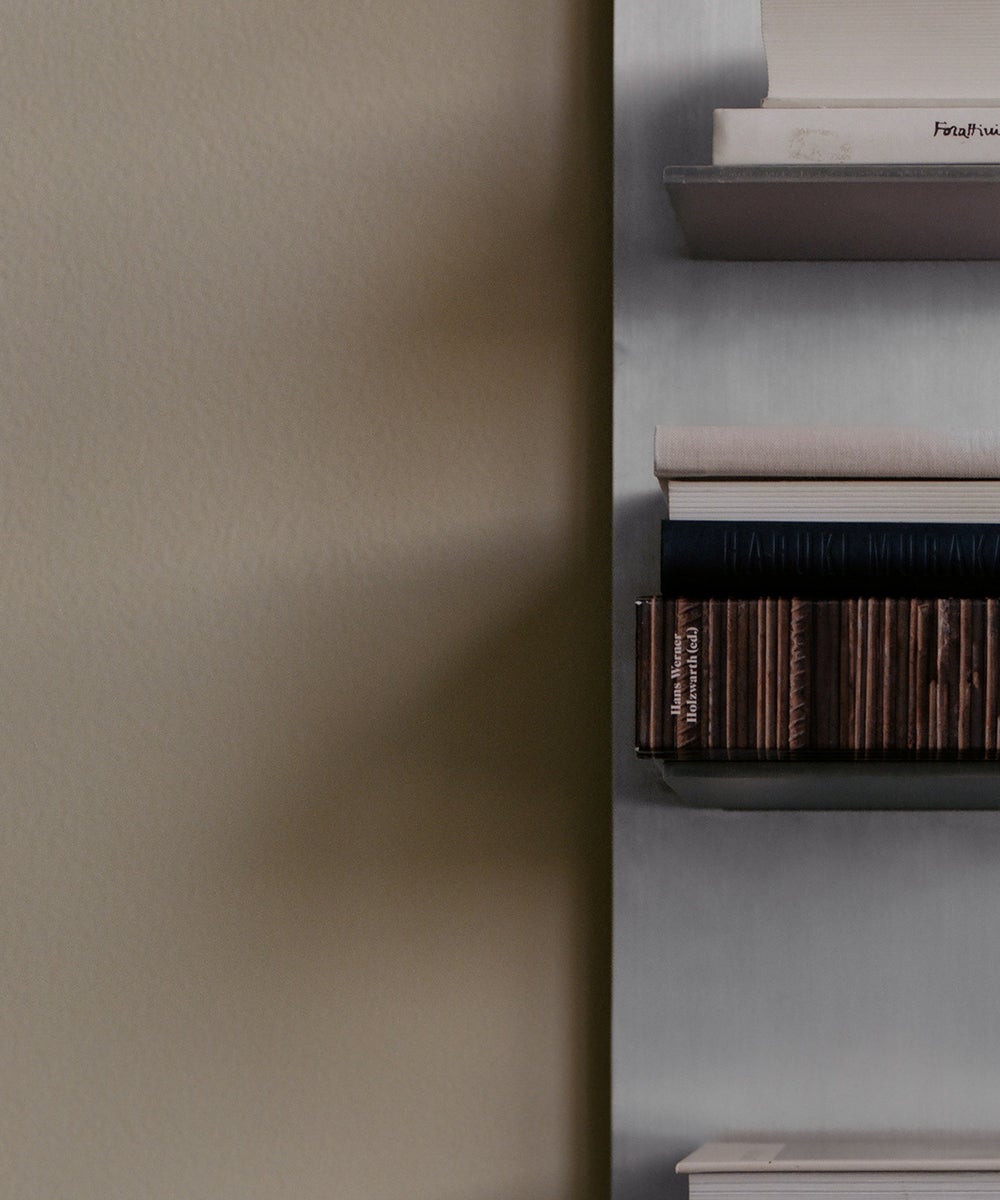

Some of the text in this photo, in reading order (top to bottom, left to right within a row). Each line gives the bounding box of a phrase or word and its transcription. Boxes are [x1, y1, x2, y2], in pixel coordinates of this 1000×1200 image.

[670, 633, 682, 715] Hans Werner
[686, 627, 699, 723] Holzwarth (ed.)
